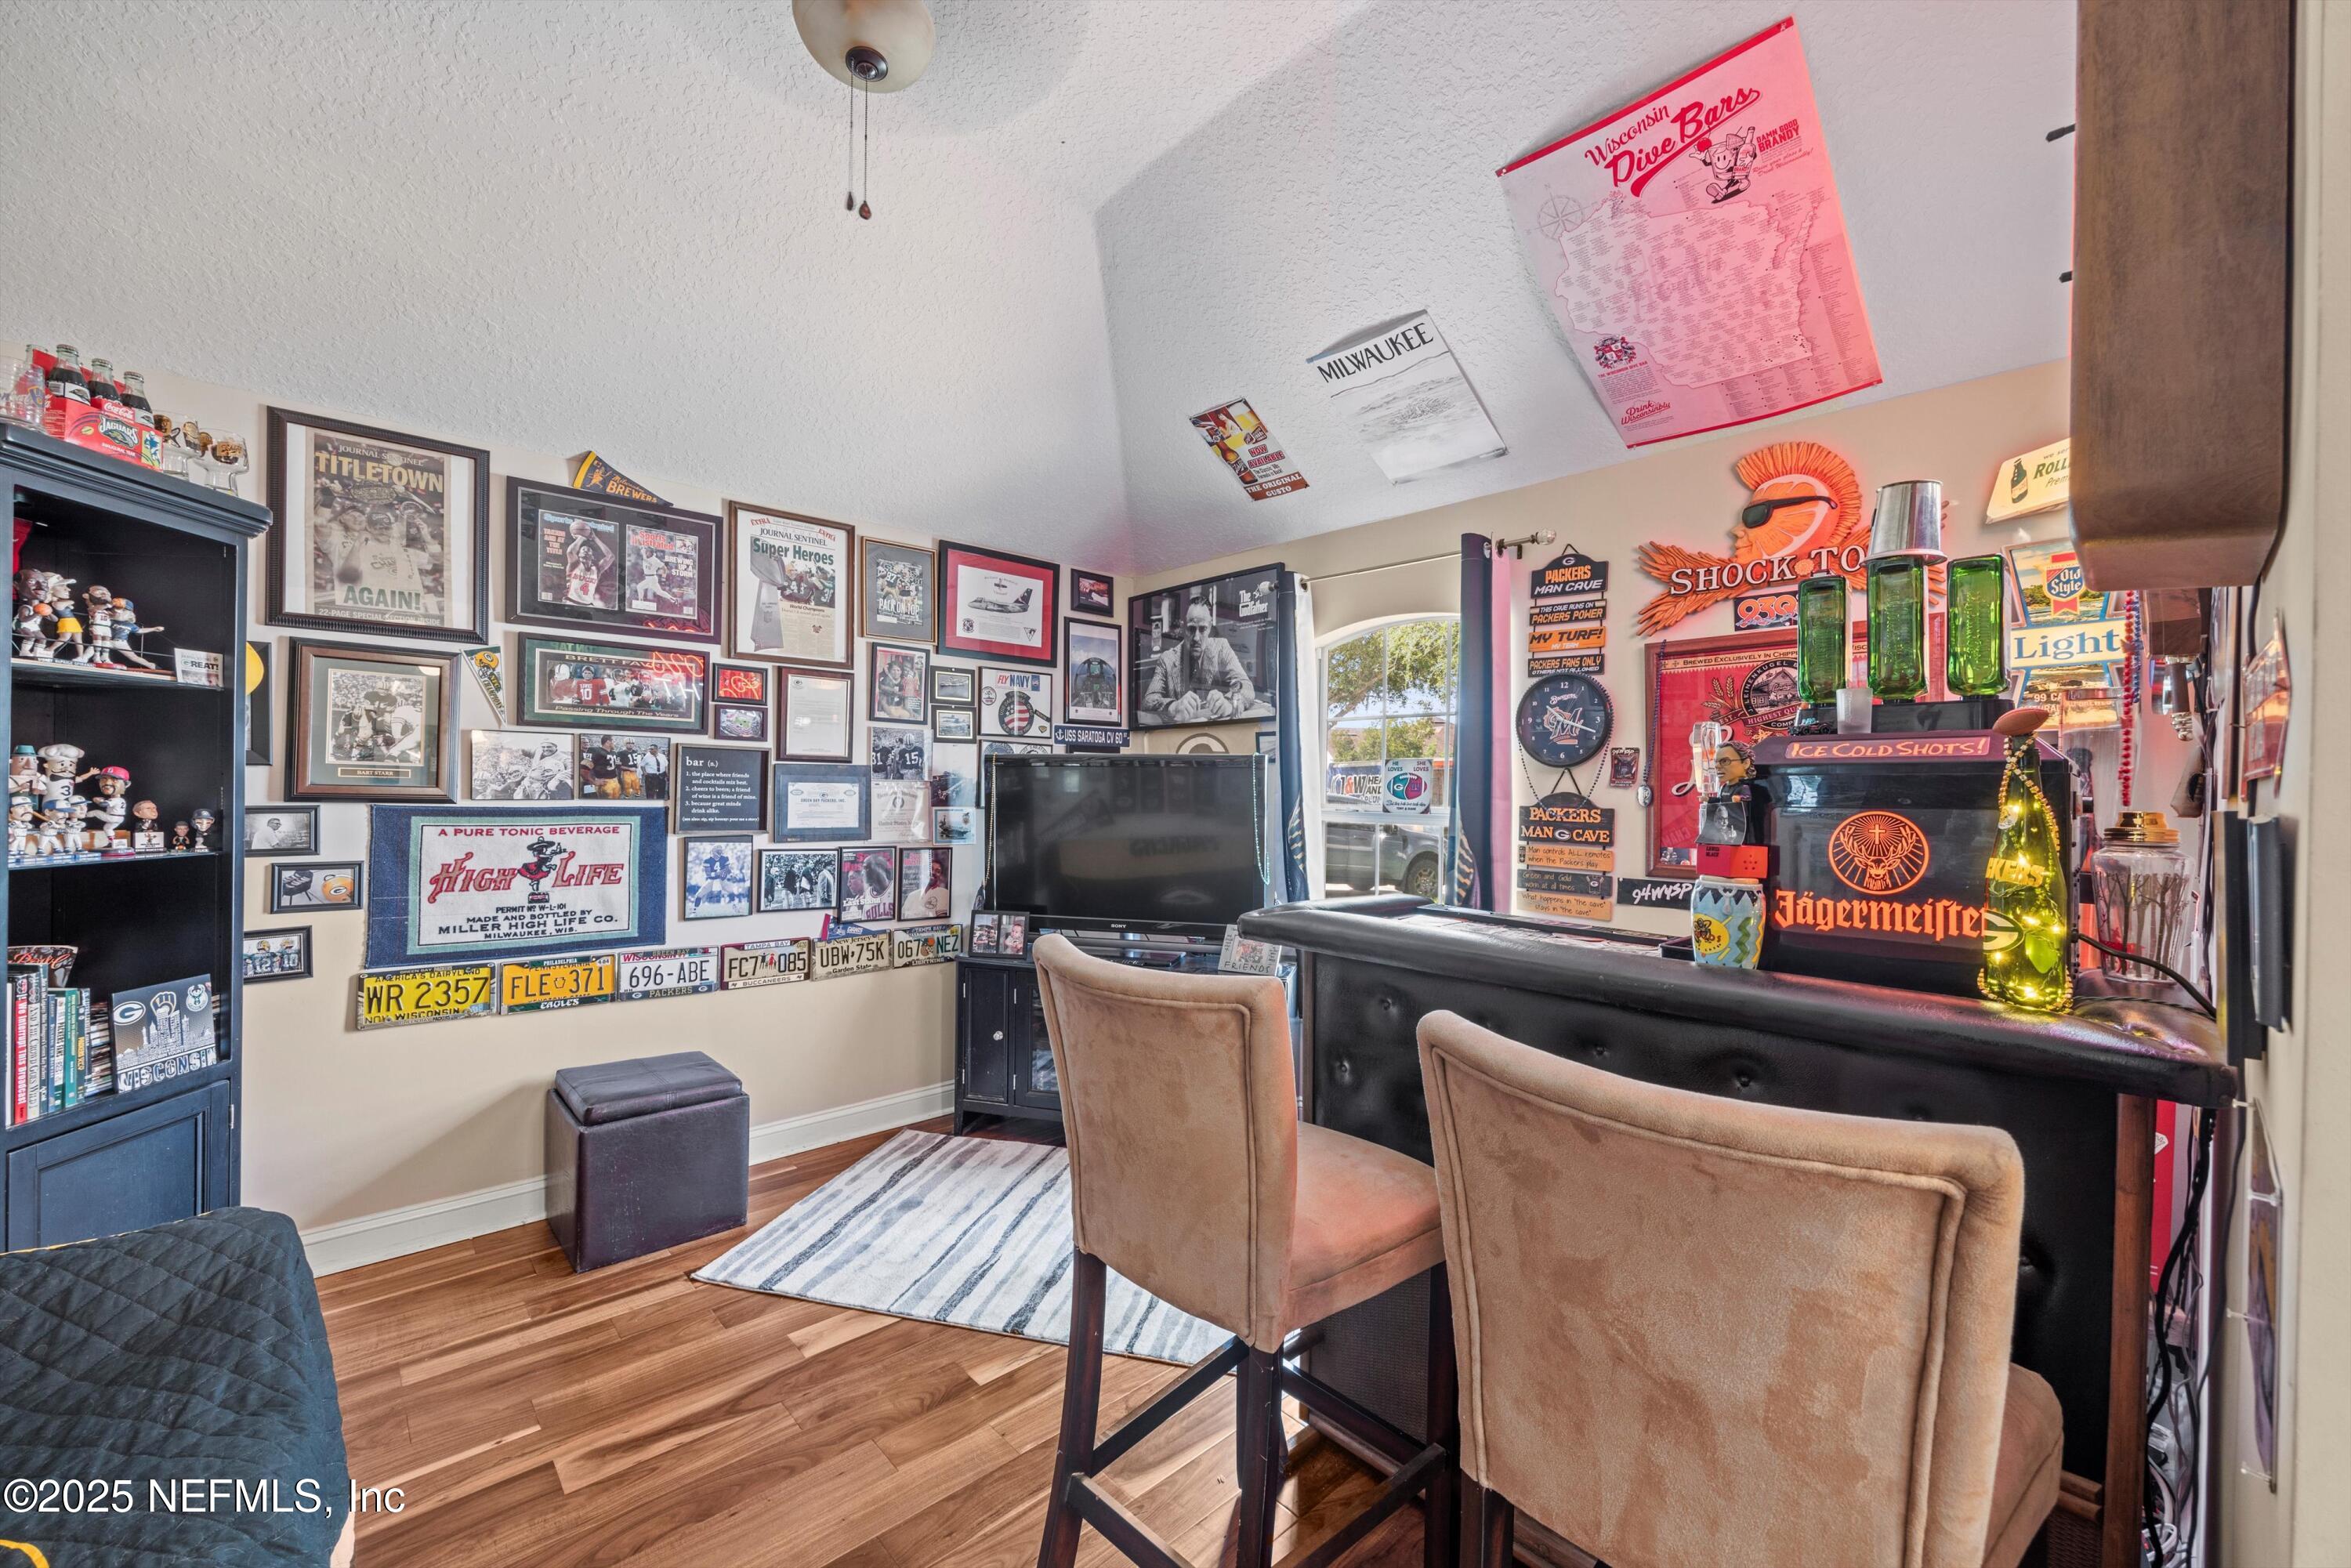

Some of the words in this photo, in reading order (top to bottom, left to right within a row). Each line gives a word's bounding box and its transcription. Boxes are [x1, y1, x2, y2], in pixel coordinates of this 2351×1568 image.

[1585, 104, 1670, 167] Wisconsin
[1604, 135, 1676, 186] Dive
[1670, 88, 1761, 143] Bars
[1756, 129, 1778, 143] DAMN
[1779, 119, 1799, 132] GOOD
[1758, 125, 1799, 152] BRANDY
[1317, 322, 1433, 383] MILWAUKEE
[1626, 400, 1654, 415] Drink
[100, 417, 139, 444] JAGUARS
[339, 444, 380, 458] JOURNAL
[1249, 445, 1267, 456] NOW
[1248, 451, 1284, 467] AVAILABLE
[315, 451, 444, 493] TITLETOWN
[1247, 484, 1261, 493] THE
[1262, 473, 1302, 490] ORIGINAL
[606, 481, 657, 504] BREWERS
[1266, 486, 1291, 497] GUSTO
[760, 527, 793, 541] JOURNAL
[794, 534, 828, 547] SENTINEL
[818, 528, 836, 542] EXTRA
[753, 538, 790, 559] Super
[792, 545, 834, 565] Heroes
[665, 556, 694, 566] BREWING
[1545, 565, 1592, 583] PACKERS
[1670, 554, 1796, 596] SHOCK
[1811, 545, 1866, 579] TO
[2059, 567, 2081, 581] Old
[1534, 585, 1562, 596] MAN
[1565, 579, 1603, 592] CAVE
[2050, 578, 2081, 598] Style
[342, 585, 421, 611] AGAIN!
[1239, 589, 1252, 603] The
[319, 608, 350, 619] 22-PAGE
[353, 610, 385, 621] SPECIAL
[878, 598, 895, 611] PACK
[896, 600, 905, 614] ON
[907, 603, 920, 616] TOP
[1239, 600, 1269, 618] Godfather
[1532, 612, 1570, 624] PACKERS
[1573, 608, 1603, 621] POWER
[1530, 632, 1552, 644] MY
[1558, 628, 1603, 642] TURF!
[2014, 629, 2121, 661] Light
[565, 654, 616, 664] BRETT
[1530, 659, 1560, 670] PACKERS
[1561, 657, 1580, 668] FANS
[1582, 655, 1602, 666] ONLY
[1714, 654, 1762, 664] EXCLUSIVELY
[998, 675, 1009, 684] FLY
[1009, 675, 1031, 688] NAVY
[580, 689, 592, 700] 10
[555, 705, 594, 714] Passing
[596, 707, 635, 716] Through
[1748, 709, 1782, 725] HIGHEST
[1064, 729, 1077, 741] USS
[1078, 730, 1105, 743] SARATOGA
[1107, 730, 1115, 743] CV
[1115, 730, 1123, 744] 60
[1791, 743, 1827, 757] ICE
[1832, 741, 1893, 757] COLD
[1896, 737, 1987, 755] SHOTS!
[686, 756, 704, 766] bar
[905, 751, 918, 765] 15
[1529, 807, 1601, 823] PACKERS
[438, 827, 448, 837] A
[453, 827, 494, 837] PURE
[498, 827, 545, 836] TONIC
[549, 826, 621, 835] BEVERAGE
[1520, 826, 1553, 838] MAN
[1572, 829, 1610, 842] CAVE
[427, 852, 520, 904] HIGH
[551, 851, 625, 889] LIFE
[495, 904, 524, 914] PERMIT
[538, 903, 567, 911] W-L-101
[530, 911, 577, 922] BOTTLED
[438, 924, 504, 935] MILLER
[509, 920, 548, 930] HIGH
[553, 918, 588, 927] LIFE
[593, 914, 618, 924] CO.
[484, 929, 552, 940] MILWAUKEE,
[820, 945, 849, 968] UBW
[856, 940, 885, 963] 75K
[897, 940, 919, 959] 067
[936, 935, 958, 954] NEZ
[728, 956, 759, 979] FC7
[778, 951, 806, 973] 085
[911, 957, 944, 966] LIGHTNING
[1224, 961, 1270, 973] FRIENDS
[430, 969, 480, 979] DAIRYLAND
[629, 960, 710, 988] 696-ABE
[742, 976, 792, 987] BUCCANEERS
[511, 973, 551, 999] FLE
[569, 966, 604, 994] 371
[367, 983, 405, 1015] WR
[415, 977, 490, 1009] 2357
[649, 987, 693, 998] PACKERS
[540, 998, 579, 1009] EAGLES
[395, 1008, 460, 1020] WISCONSIN
[29, 1040, 38, 1064] CROWD
